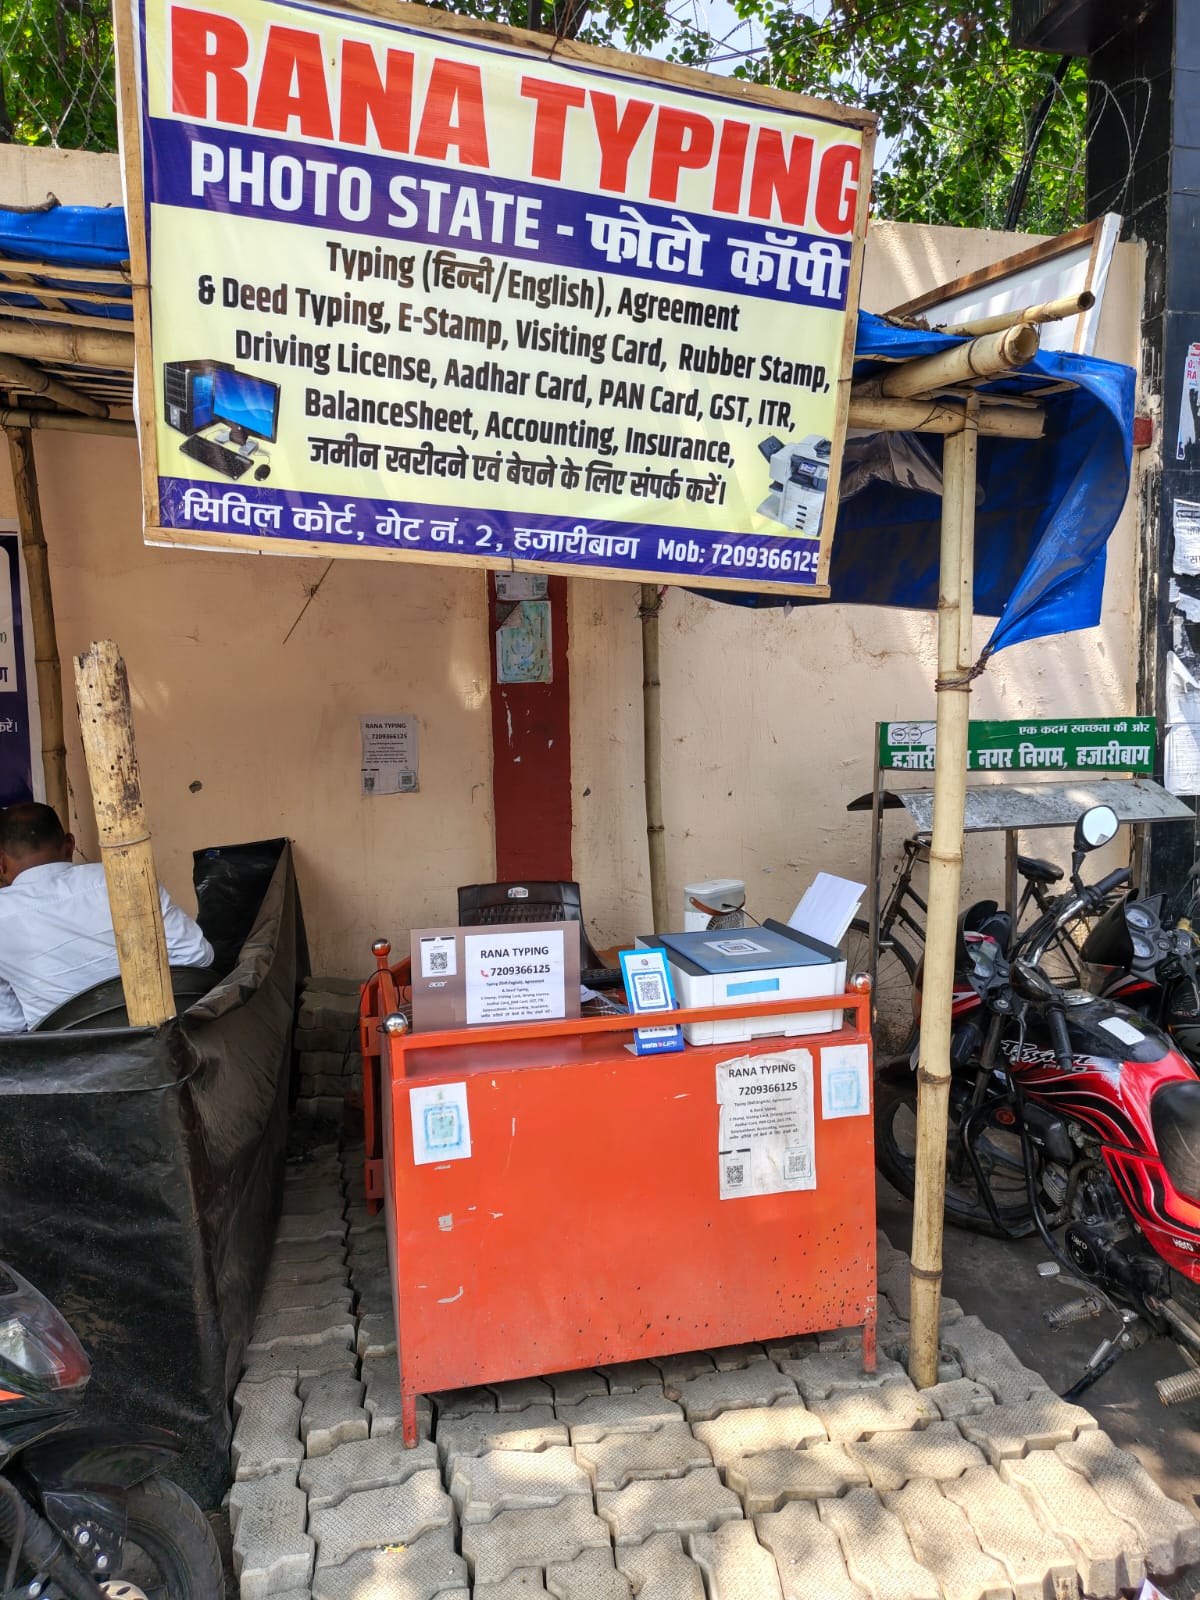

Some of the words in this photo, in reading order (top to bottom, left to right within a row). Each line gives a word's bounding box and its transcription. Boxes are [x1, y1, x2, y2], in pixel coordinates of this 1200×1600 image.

[171, 4, 490, 168] RANA
[520, 75, 862, 236] TYPING
[191, 140, 372, 222] PHOTO
[387, 175, 542, 250] STATE
[556, 224, 574, 236] -
[585, 205, 711, 276] फोटो
[726, 231, 851, 300] कॉपी
[326, 241, 415, 288] Typing
[422, 249, 611, 319] (हिन्दी/English),
[617, 287, 740, 332] Agreement
[198, 274, 216, 305] &
[222, 277, 288, 315] Deed
[295, 287, 391, 335] Typing,
[398, 302, 509, 350] E-Stamp,
[516, 319, 607, 365] Visiting
[611, 333, 668, 372] Card,
[679, 343, 757, 379] Rubber
[759, 355, 831, 394] Stamp,
[235, 329, 331, 375] Driving
[337, 342, 437, 389] License,
[444, 358, 530, 396] Aadhar
[535, 369, 592, 408] Card,
[599, 379, 645, 411] PAN
[650, 386, 703, 422] Card,
[710, 393, 753, 428] GST,
[758, 400, 797, 432] ITR,
[305, 387, 478, 441] BalanceSheet,
[485, 411, 619, 456] Accounting,
[625, 427, 735, 468] Insurance,
[308, 433, 381, 470] जमीन
[384, 441, 469, 481] खरीदने
[471, 451, 503, 484] एवं
[506, 451, 558, 488] बेचने
[561, 457, 580, 491] के
[584, 459, 628, 496] लिए
[629, 466, 684, 500] संपर्क
[686, 473, 728, 505] करें।
[182, 487, 284, 530] सिविल
[291, 500, 365, 542] कोर्ट,
[375, 506, 424, 542] गेट
[429, 518, 464, 546] नं.
[475, 524, 503, 553] 2,
[513, 524, 641, 560] हजारीबाग
[657, 538, 705, 564] Mob:
[711, 543, 820, 574] 7209366125
[977, 748, 1014, 769] नगर
[1018, 742, 1068, 770] निगम,
[1076, 740, 1150, 766] हजारीबाग
[1018, 726, 1037, 736] एक
[1040, 724, 1068, 735] कदम
[1071, 723, 1110, 734] स्वच्छता
[1113, 721, 1128, 733] की
[1131, 721, 1150, 733] ओर
[480, 948, 510, 959] RANA
[512, 946, 549, 956] TYPING
[490, 964, 551, 976] 7209366125
[728, 1066, 757, 1078] RANA
[760, 1063, 796, 1075] TYPING
[738, 1081, 798, 1096] 7209366125
